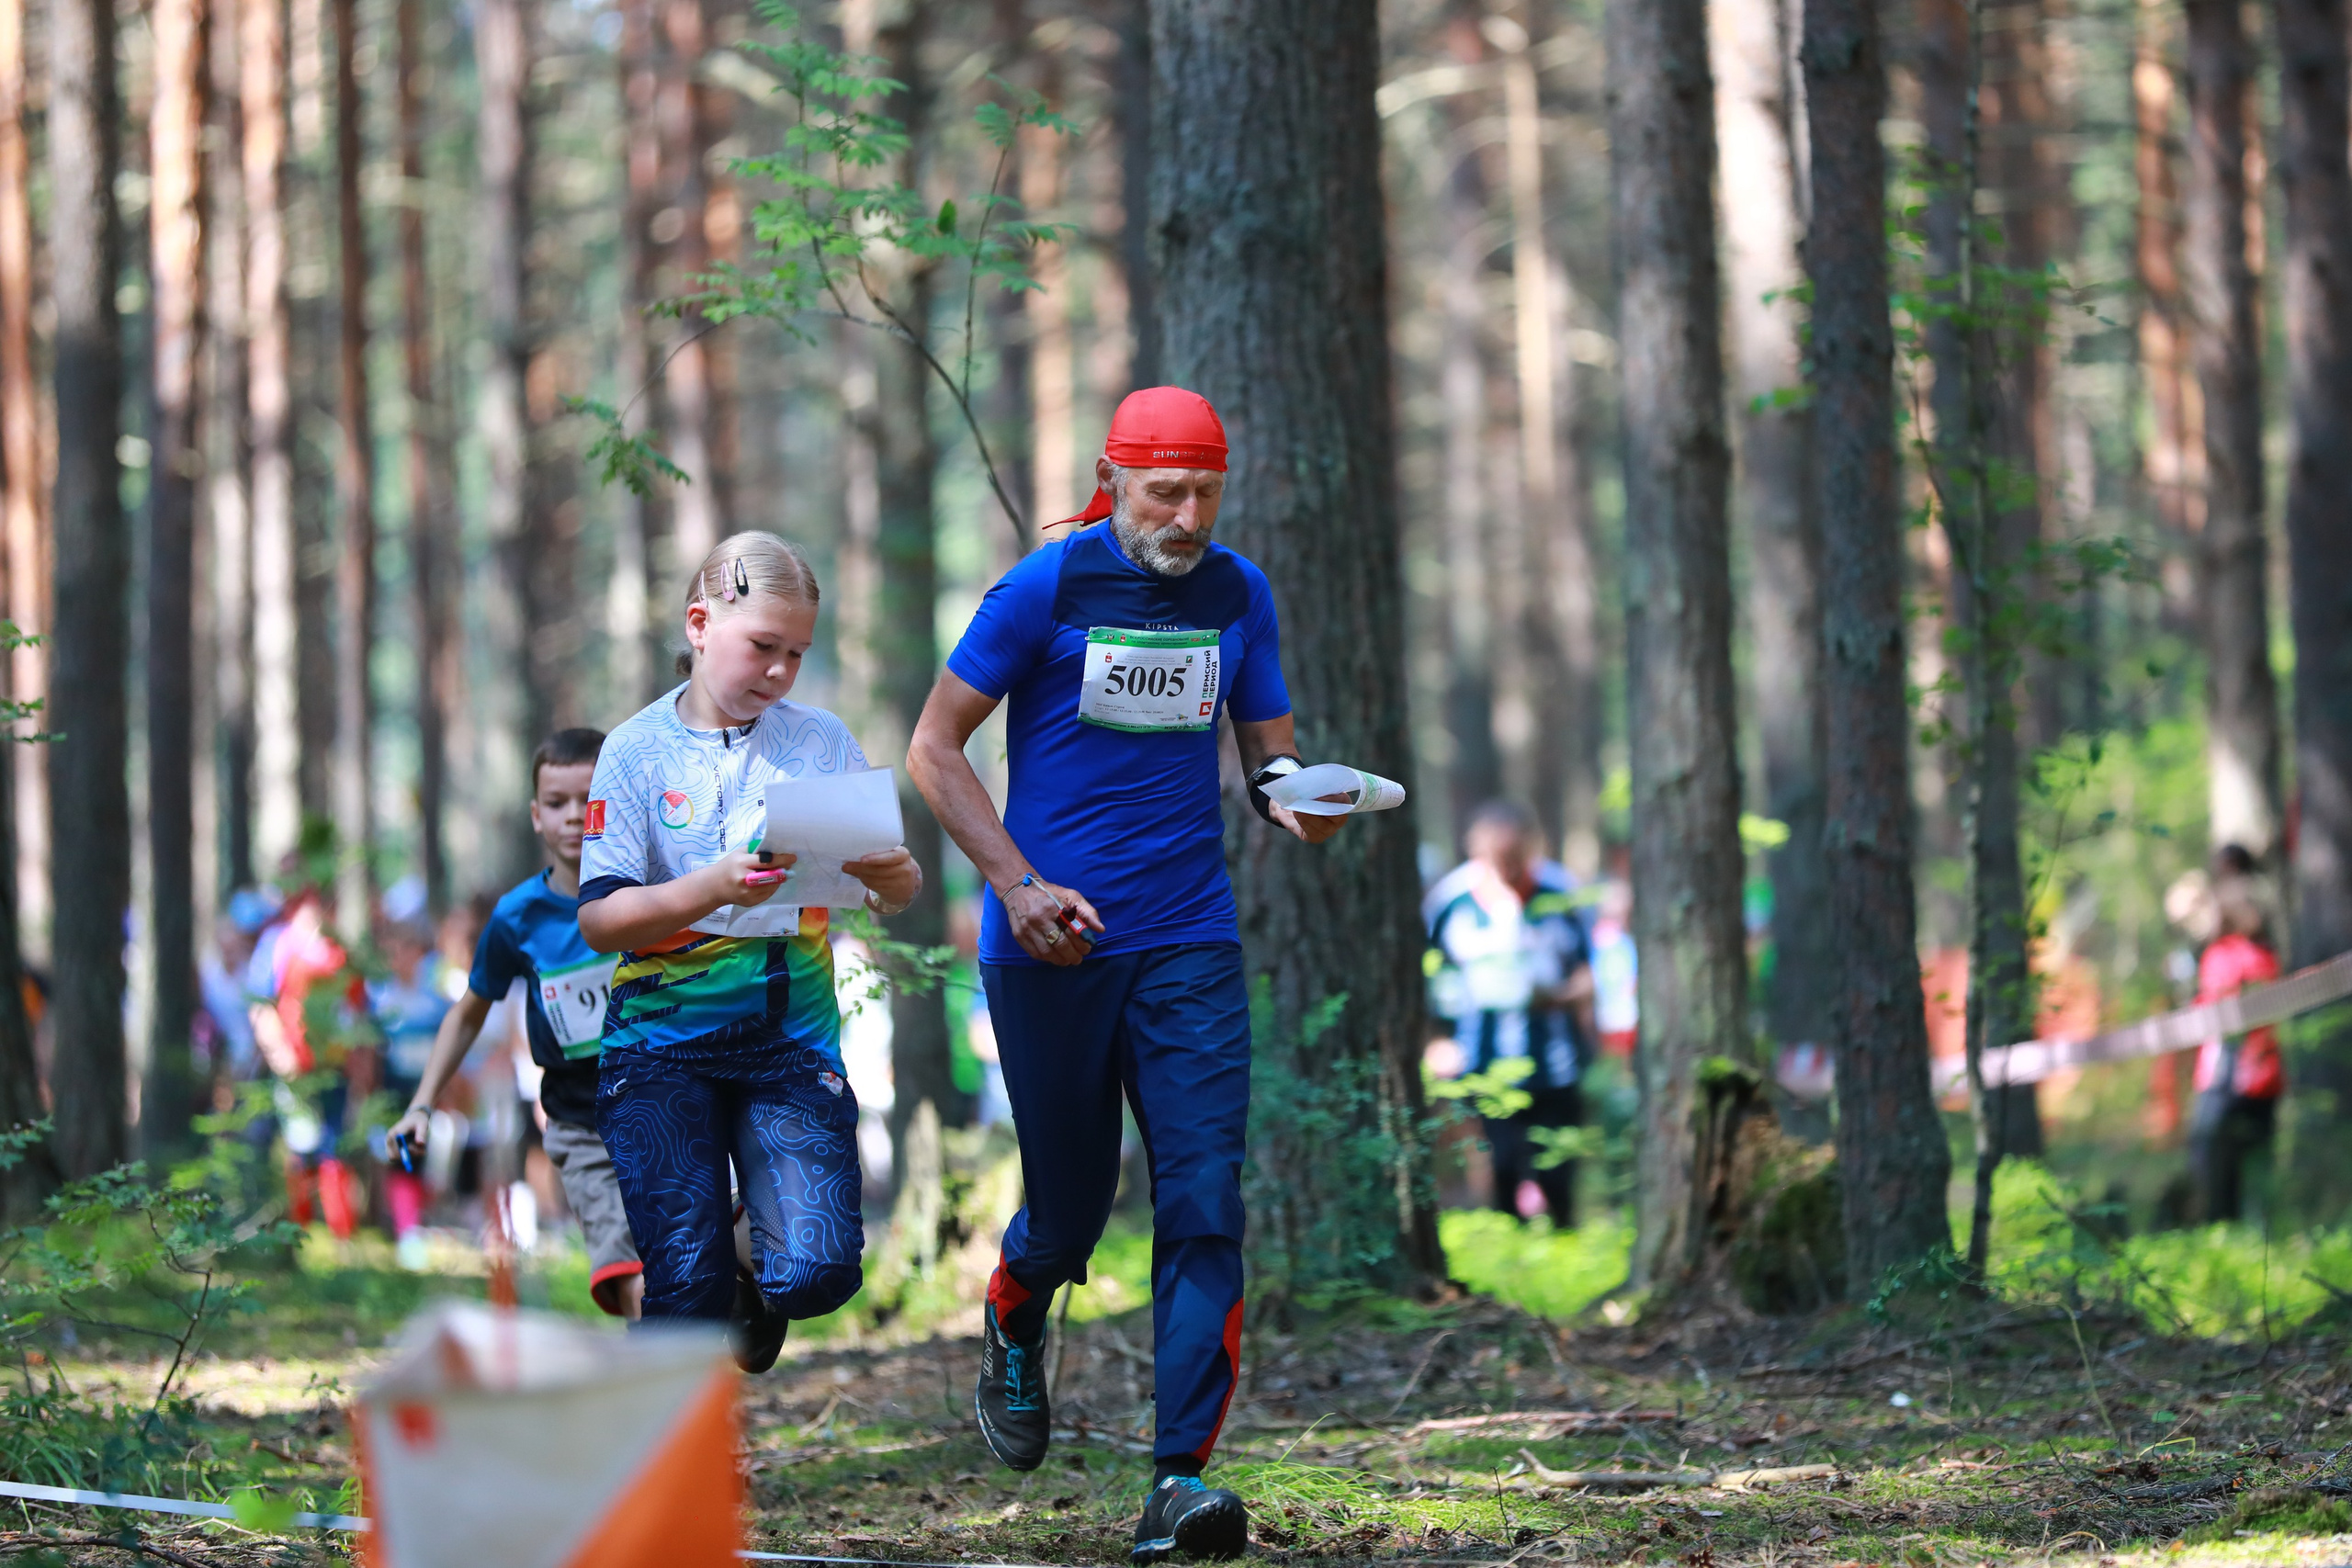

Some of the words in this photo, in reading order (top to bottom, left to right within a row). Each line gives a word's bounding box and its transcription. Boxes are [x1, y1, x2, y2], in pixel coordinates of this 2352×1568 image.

[1104, 664, 1188, 697] 5005
[1202, 649, 1211, 698] ПЕРМСКИЙ
[1208, 660, 1218, 698] ПЕРИОД
[713, 764, 725, 816] VICTORY
[718, 820, 727, 852] CODE
